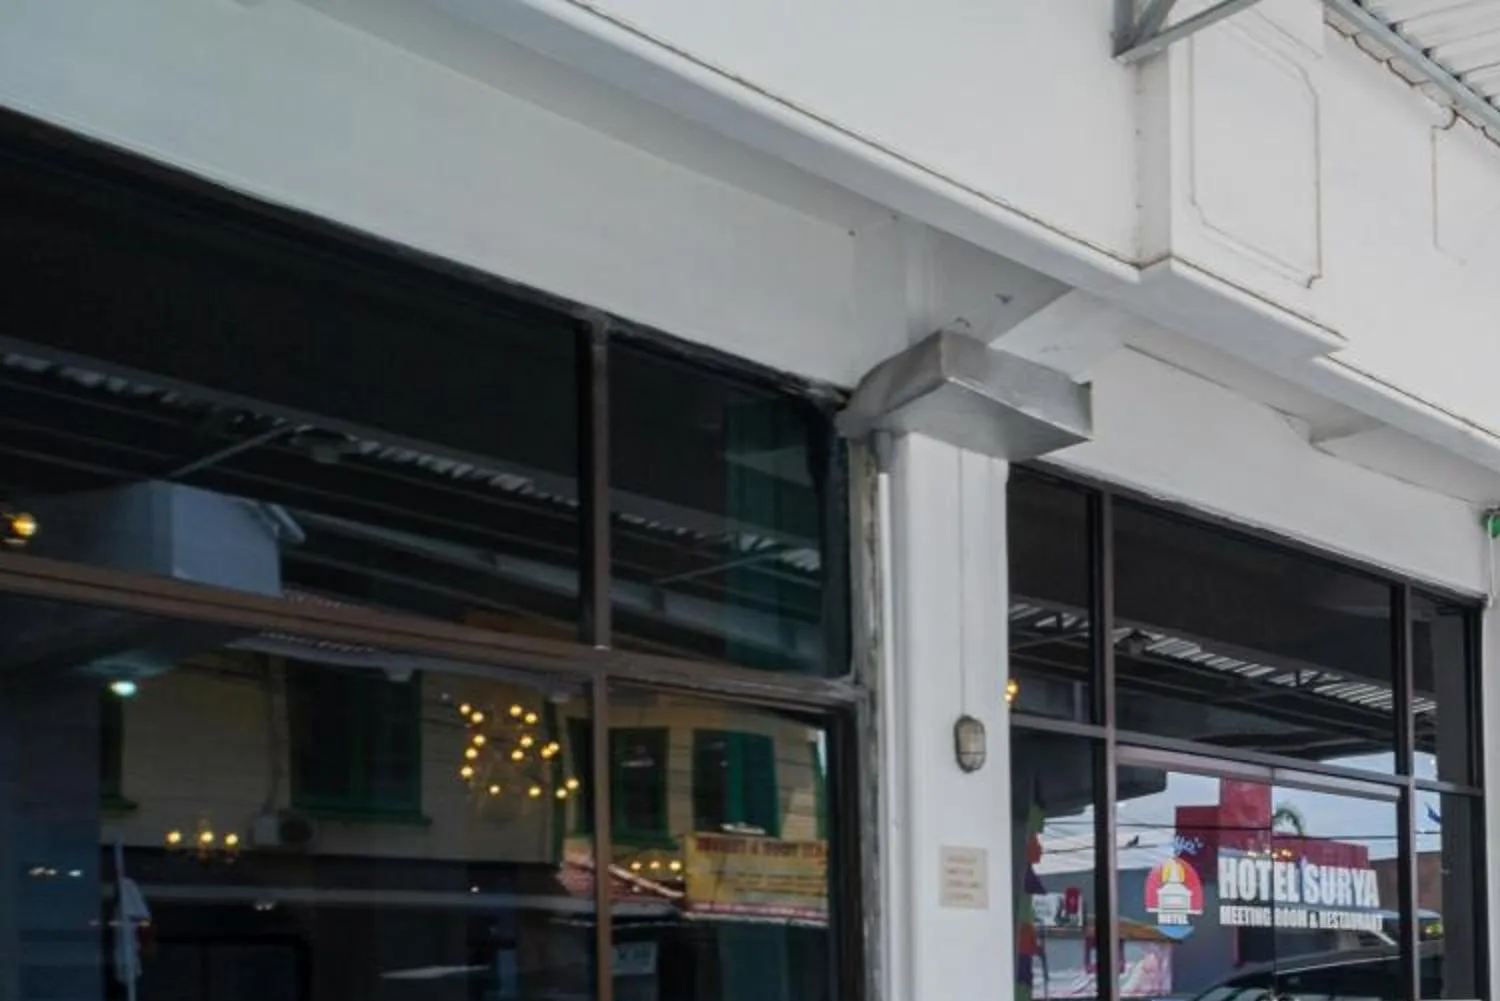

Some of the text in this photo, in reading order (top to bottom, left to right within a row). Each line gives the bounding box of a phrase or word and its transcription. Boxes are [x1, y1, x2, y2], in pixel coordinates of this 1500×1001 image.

[1218, 857, 1379, 907] HOTEL SURYA
[1219, 905, 1273, 927] MEETING
[1274, 907, 1308, 928] ROOM
